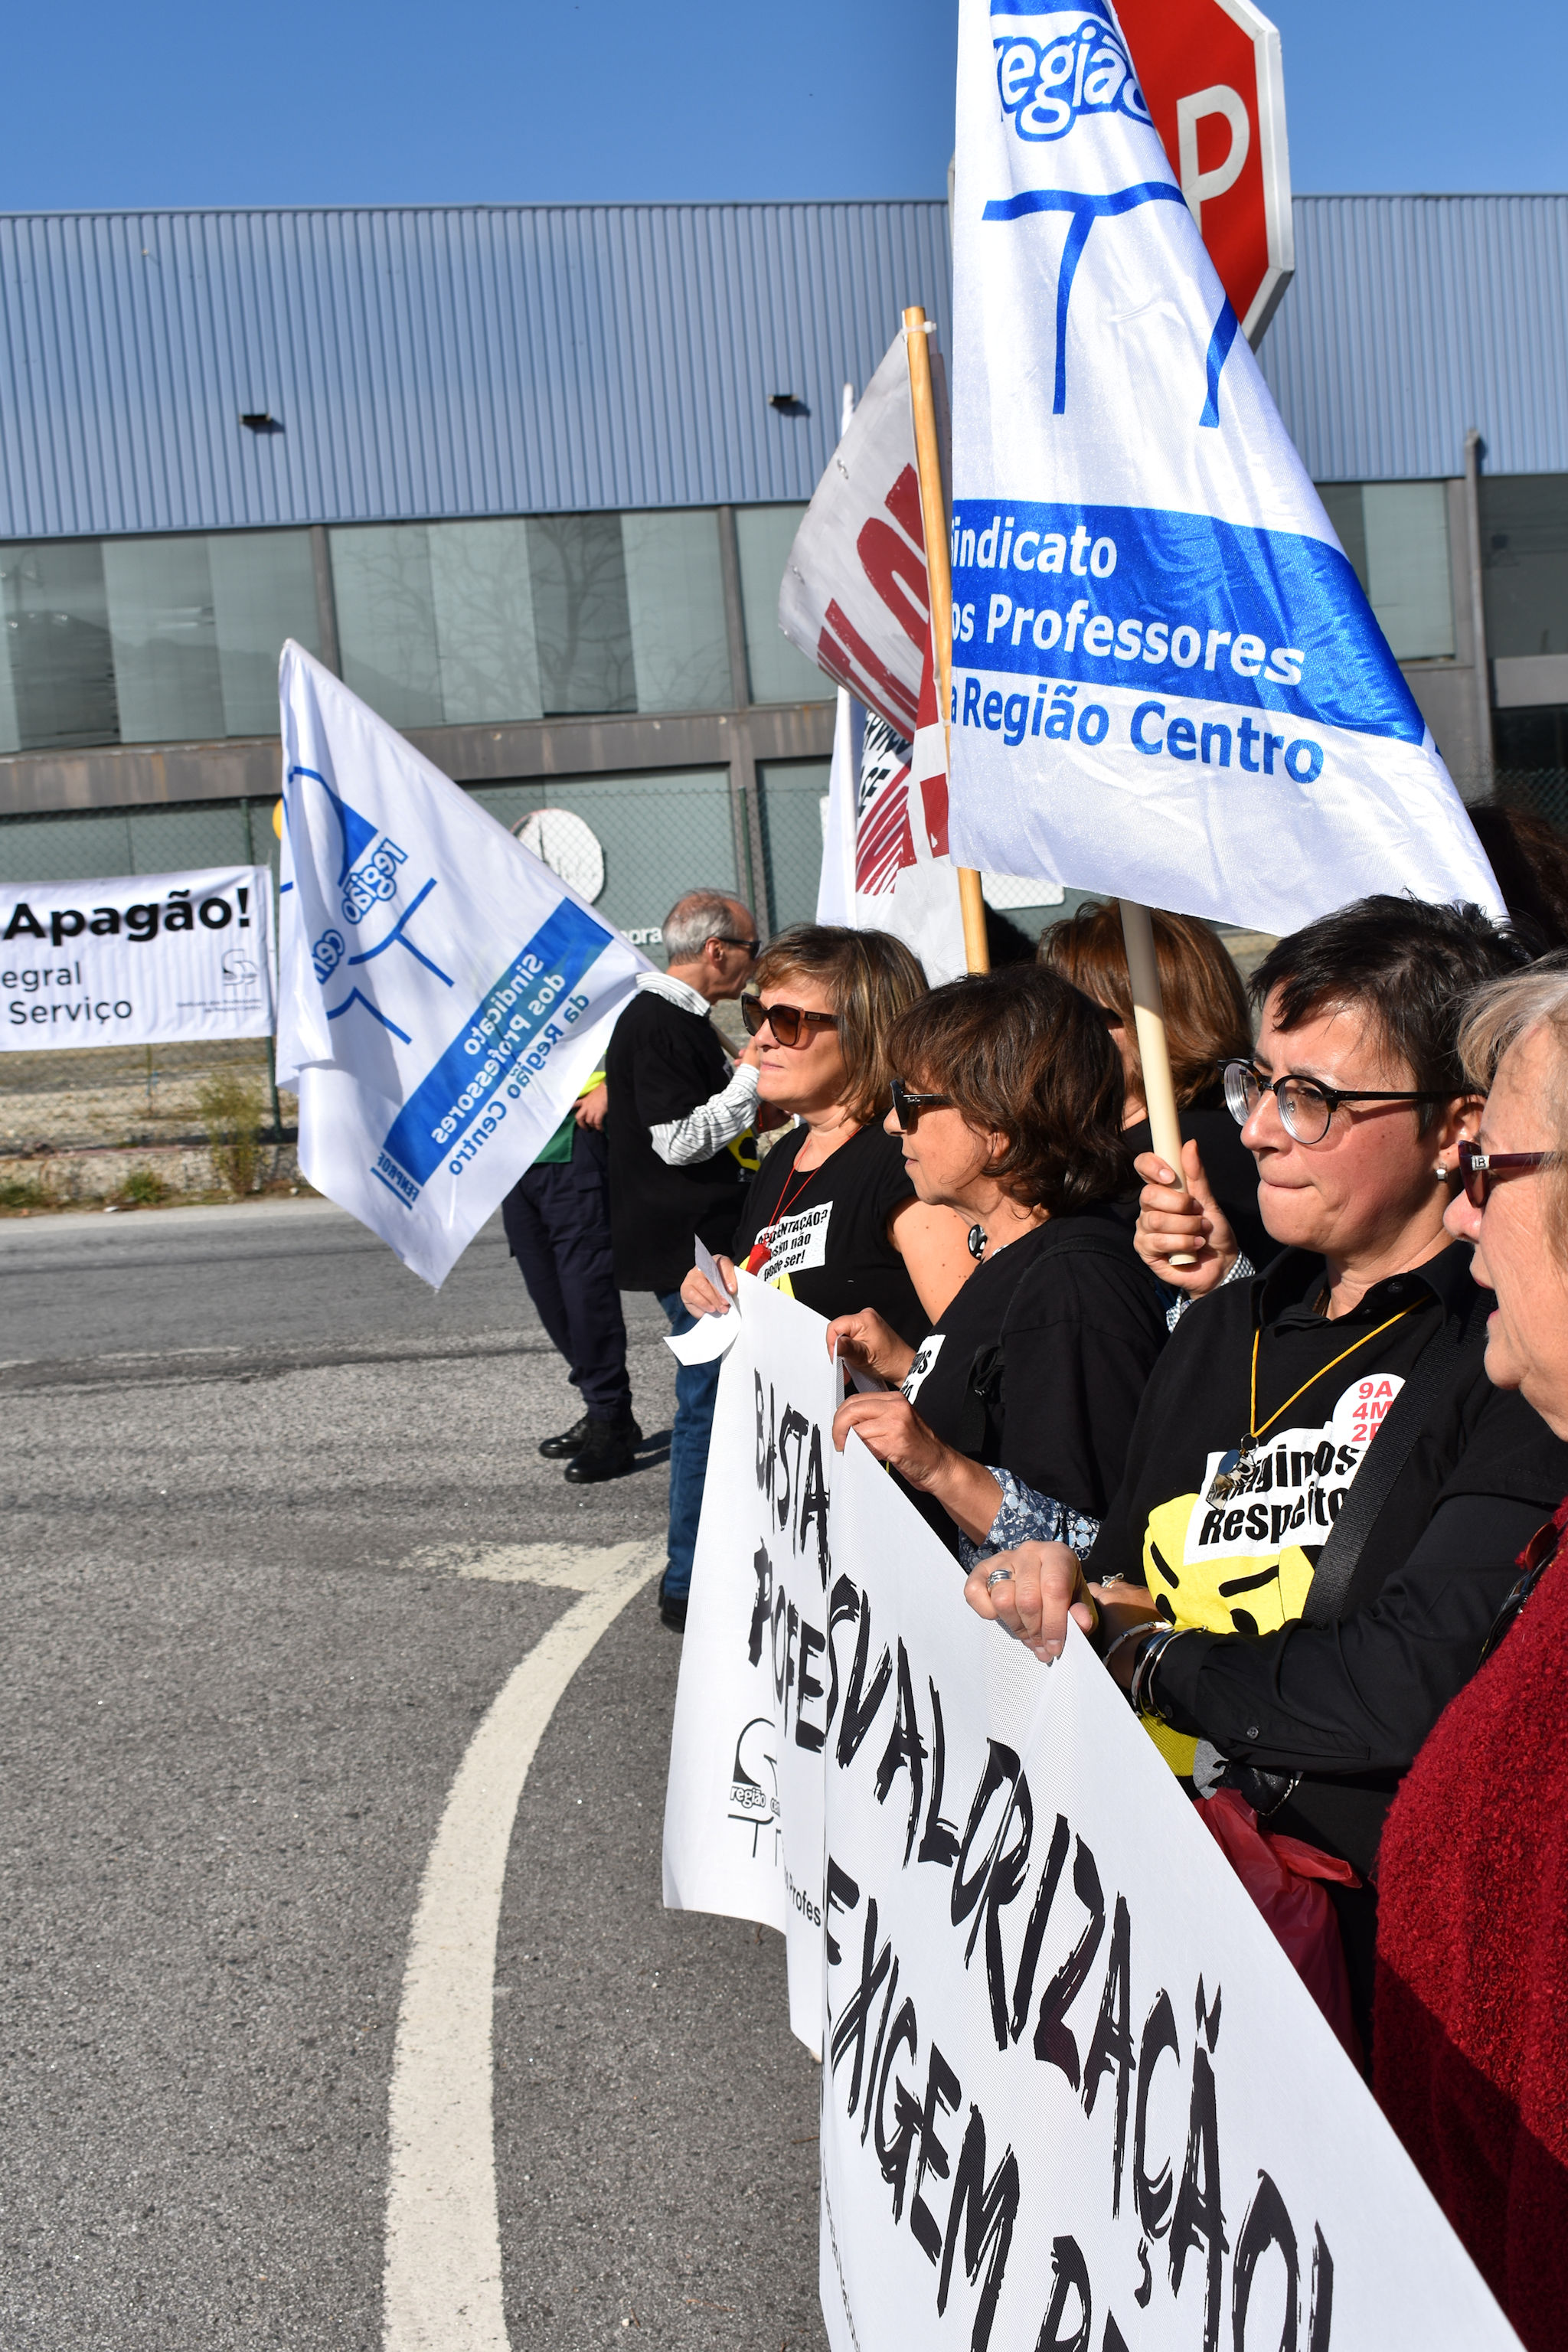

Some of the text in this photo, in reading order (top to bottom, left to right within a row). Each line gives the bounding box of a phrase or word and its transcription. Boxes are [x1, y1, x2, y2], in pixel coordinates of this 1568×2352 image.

[951, 515, 1118, 579] indicato
[985, 593, 1305, 686] Professores
[962, 677, 1109, 746] Região
[1130, 700, 1325, 784] Centro
[2, 887, 250, 947] Apagão!
[2, 962, 82, 993] egral
[9, 997, 133, 1025] Serviço
[790, 1232, 812, 1250] não
[784, 1250, 806, 1269] ser!
[1358, 1380, 1393, 1400] 9A
[1352, 1400, 1393, 1420] 4M
[753, 1367, 831, 1593] BASTA
[730, 1786, 766, 1809] região
